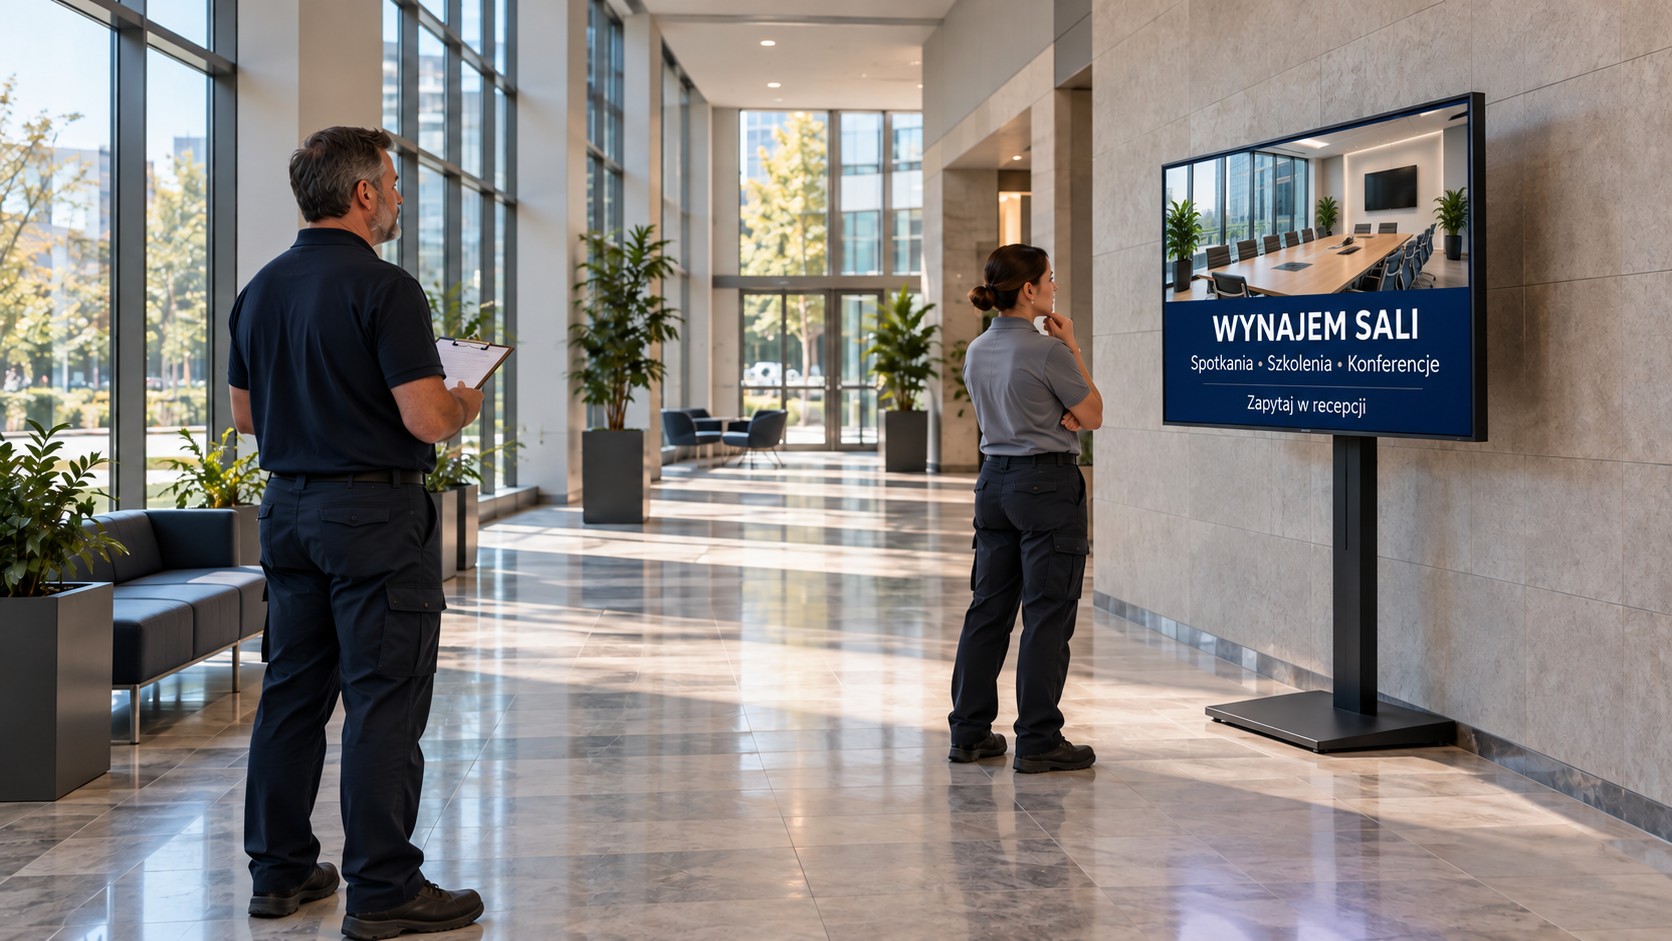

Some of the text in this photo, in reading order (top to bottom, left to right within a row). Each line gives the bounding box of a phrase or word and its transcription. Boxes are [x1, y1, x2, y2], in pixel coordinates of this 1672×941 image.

[1212, 307, 1418, 342] WYNAJEM SALI
[1190, 353, 1440, 378] Spotkania Szkolenia Konferencje
[1247, 394, 1366, 419] Zapytaj w recepcji
